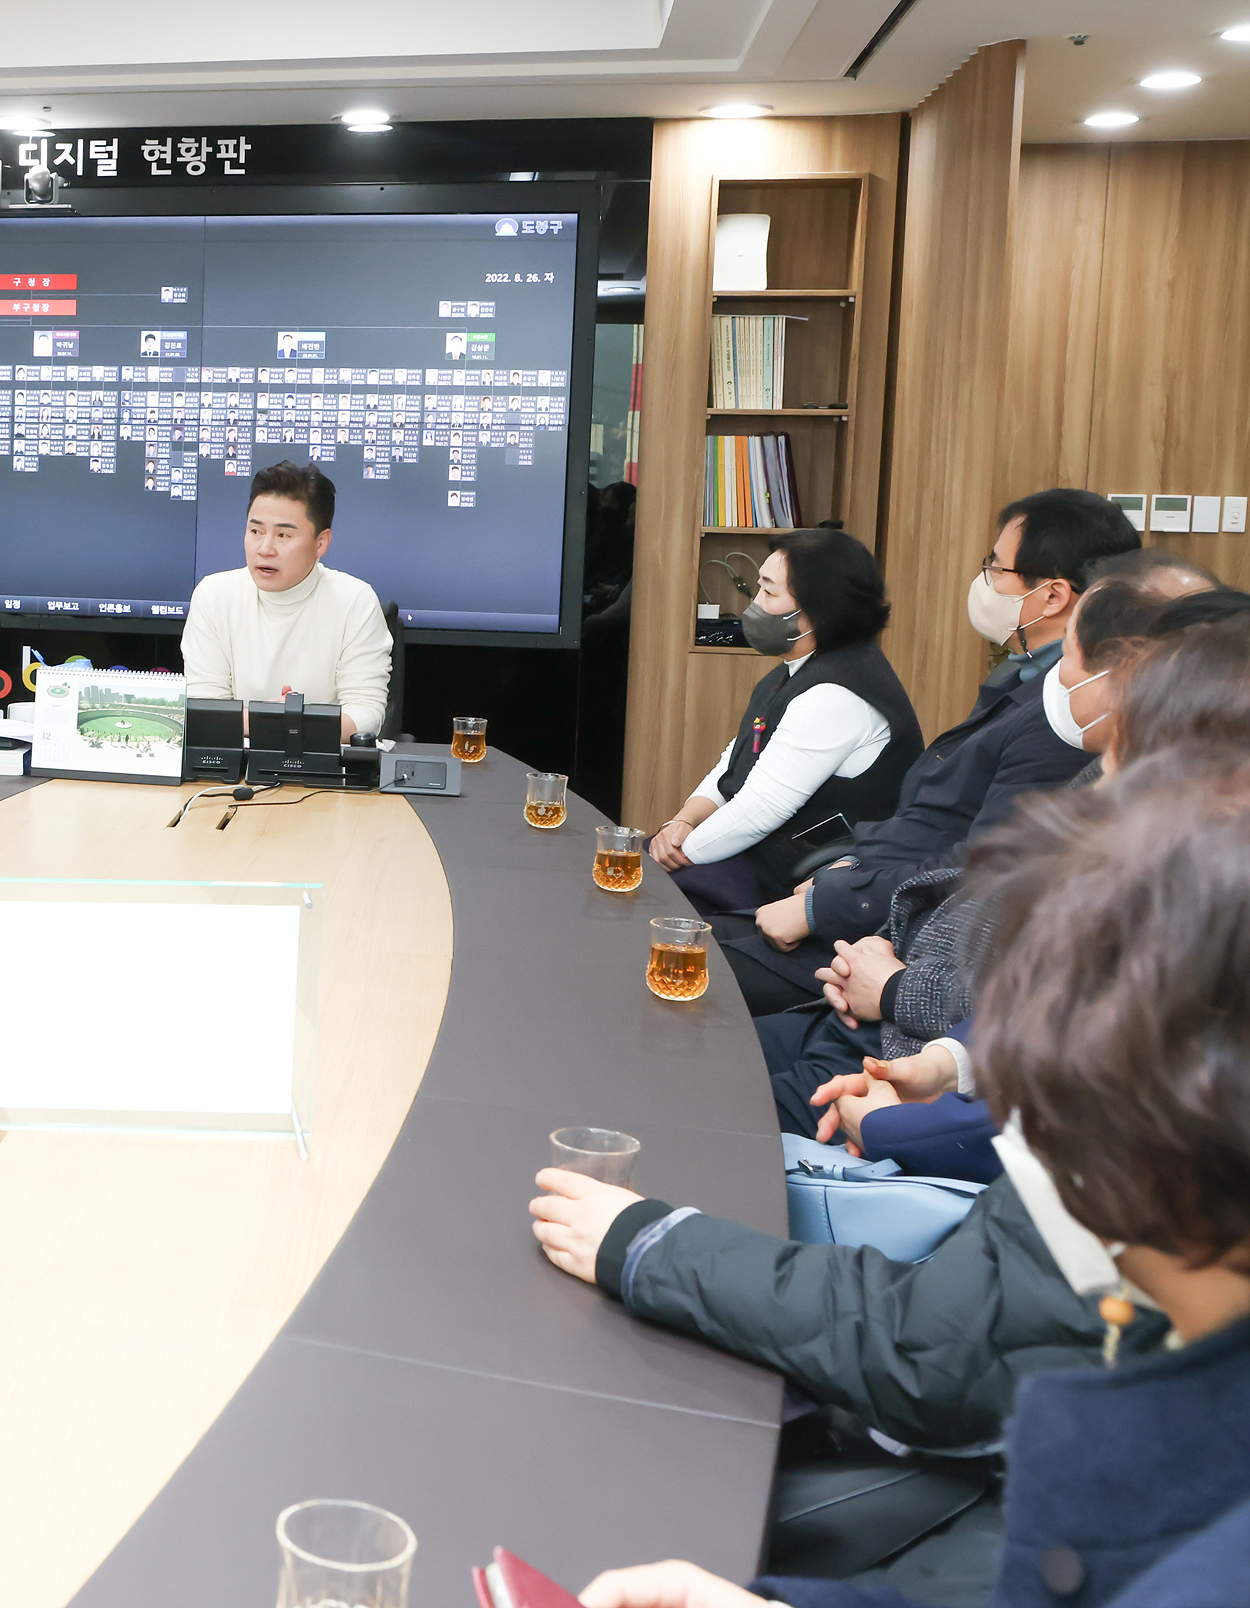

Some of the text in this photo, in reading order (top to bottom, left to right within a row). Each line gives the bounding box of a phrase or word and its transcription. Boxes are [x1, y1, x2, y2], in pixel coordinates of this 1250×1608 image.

[18, 137, 119, 177] 디지털
[140, 136, 252, 176] 현황판
[521, 220, 563, 235] 도봉구
[4, 599, 21, 609] 일정
[47, 600, 80, 611] 업무보고
